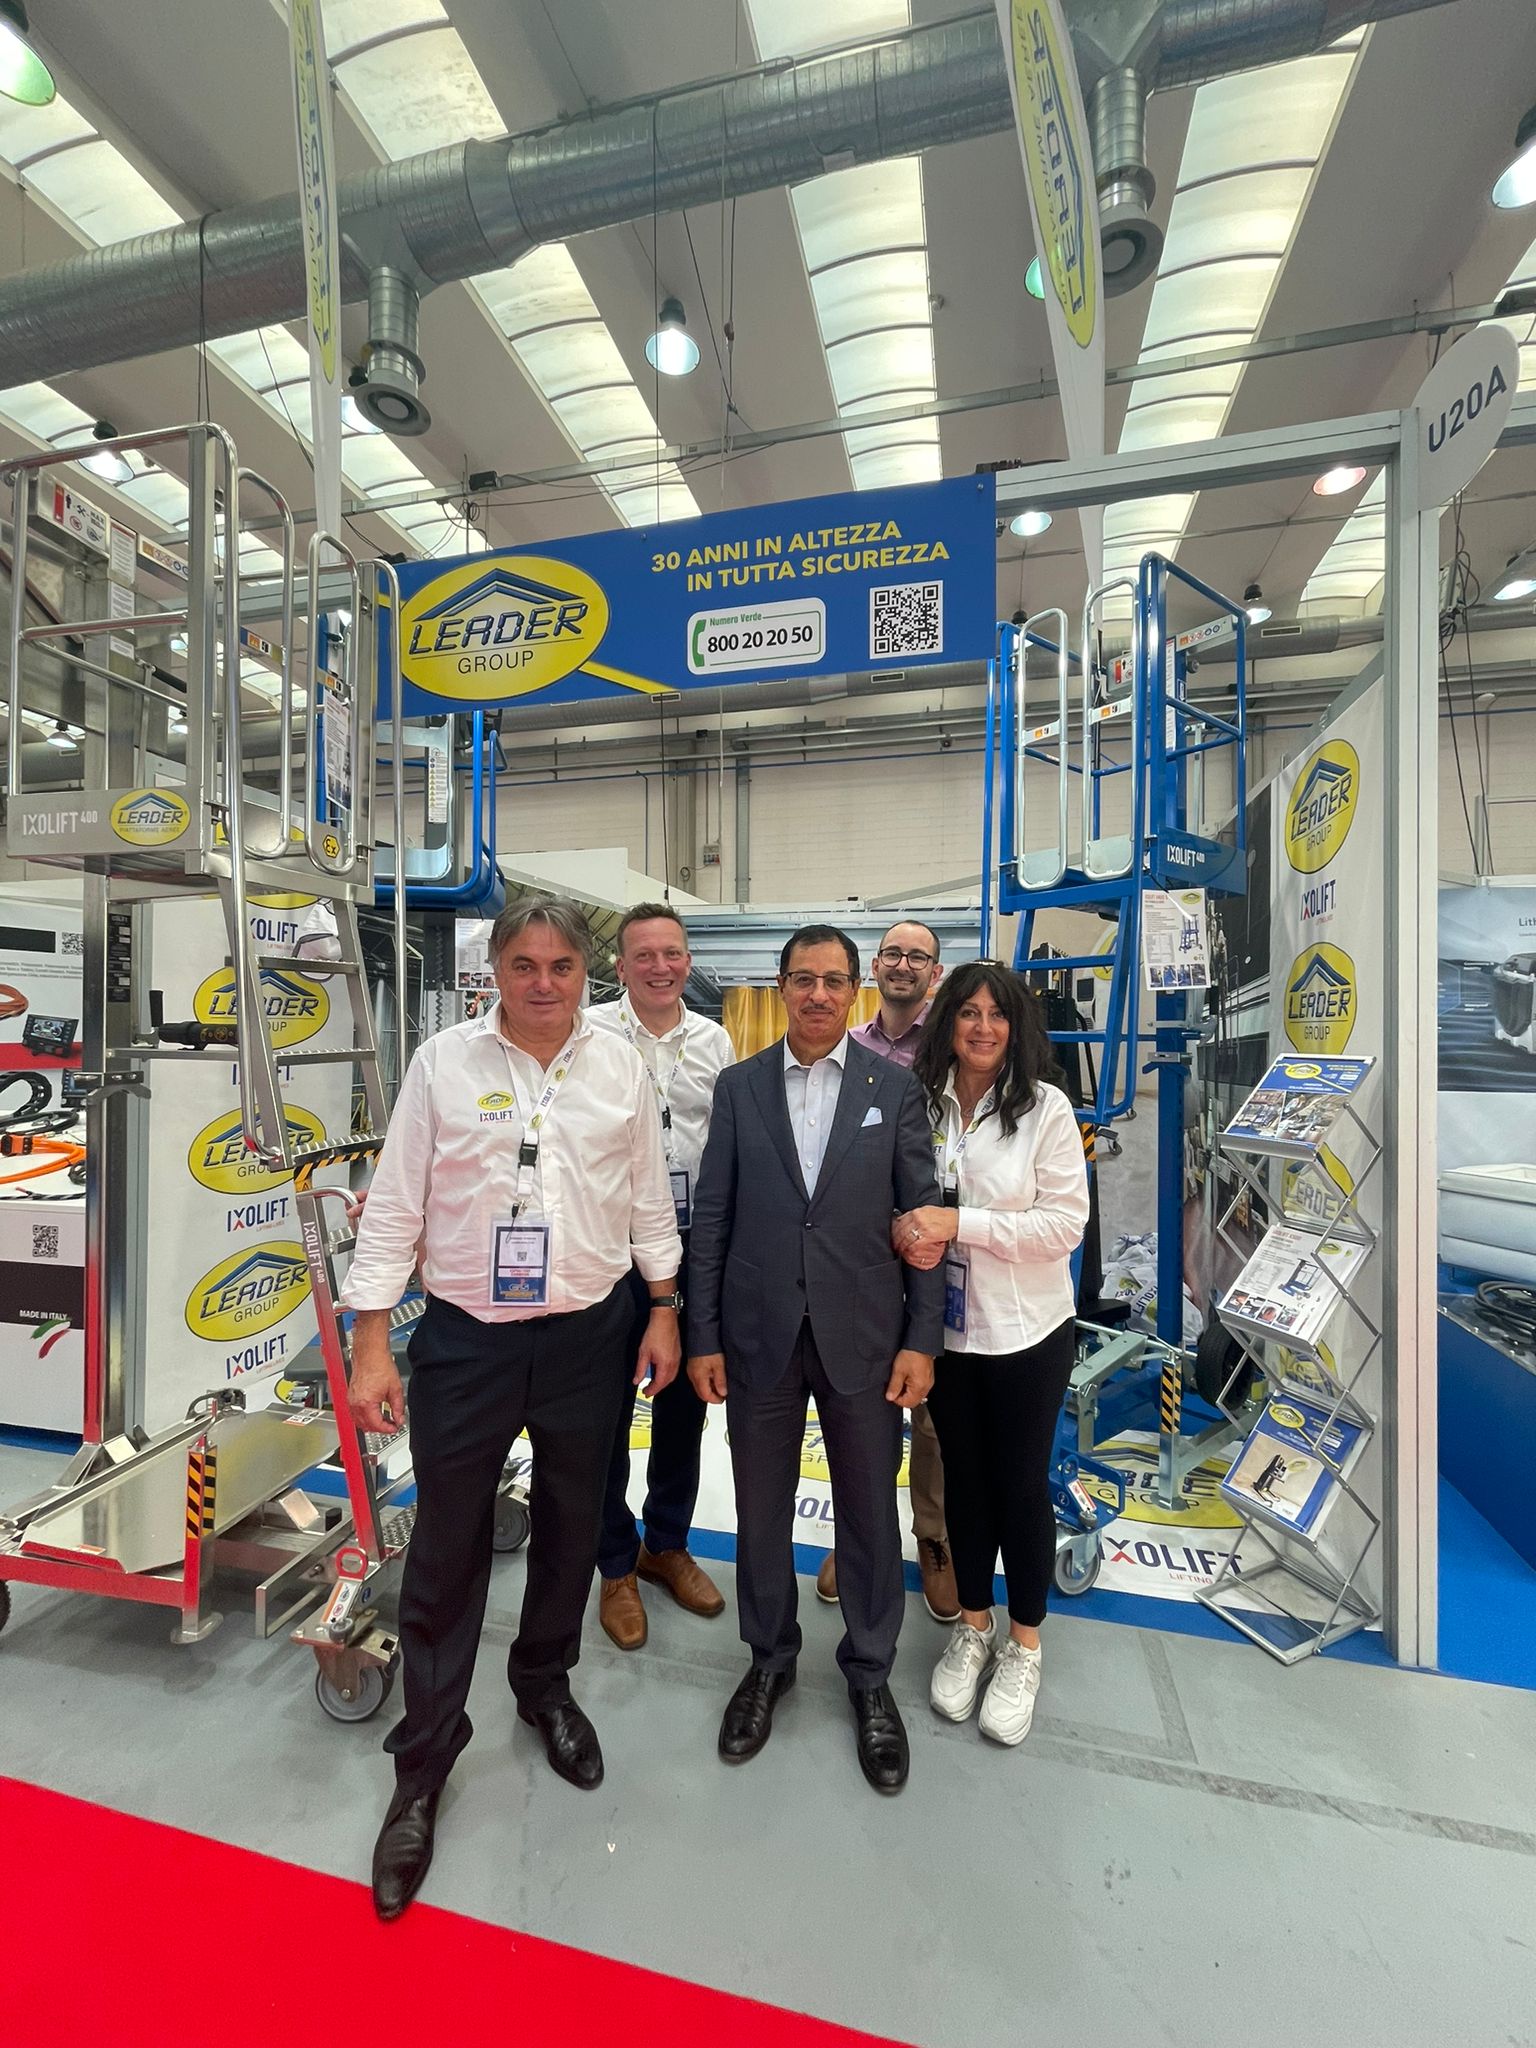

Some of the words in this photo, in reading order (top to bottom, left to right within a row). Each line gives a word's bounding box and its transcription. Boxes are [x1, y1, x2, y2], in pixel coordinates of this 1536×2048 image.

[1429, 364, 1507, 452] U20A
[651, 551, 681, 573] 30
[686, 541, 748, 567] ANNI
[756, 536, 782, 557] IN
[788, 520, 902, 552] ALTEZZA
[687, 572, 712, 592] IN
[718, 560, 796, 588] TUTTA
[801, 541, 950, 577] SICUREZZA
[409, 602, 589, 655] LEADER
[710, 614, 738, 627] Numero
[740, 611, 762, 623] Verde
[707, 633, 739, 653] 800
[742, 631, 763, 650] 20
[766, 628, 787, 646] 20
[791, 625, 813, 643] 50
[458, 650, 534, 674] GROUP
[117, 810, 183, 825] LEADER
[1291, 773, 1352, 841] LEADER
[23, 812, 78, 836] IXOLIFT
[80, 810, 98, 824] 400
[1306, 824, 1332, 852] GROUP
[1167, 844, 1196, 867] IXOLIFT
[1301, 879, 1336, 920] IXOLIFT
[209, 995, 319, 1017] LEDER
[1288, 988, 1351, 1019] LEADER
[1304, 1025, 1330, 1041] GROUP
[480, 1110, 513, 1122] IXOLIFT
[227, 1197, 288, 1232] IXOLIFT
[303, 1221, 322, 1267] IXOLIFT
[200, 1263, 308, 1319] LEADER
[19, 1309, 40, 1319] MADE
[41, 1311, 48, 1319] IN
[49, 1312, 67, 1321] ITALY
[234, 1297, 280, 1323] GROUP
[226, 1333, 288, 1380] IXOLIFT
